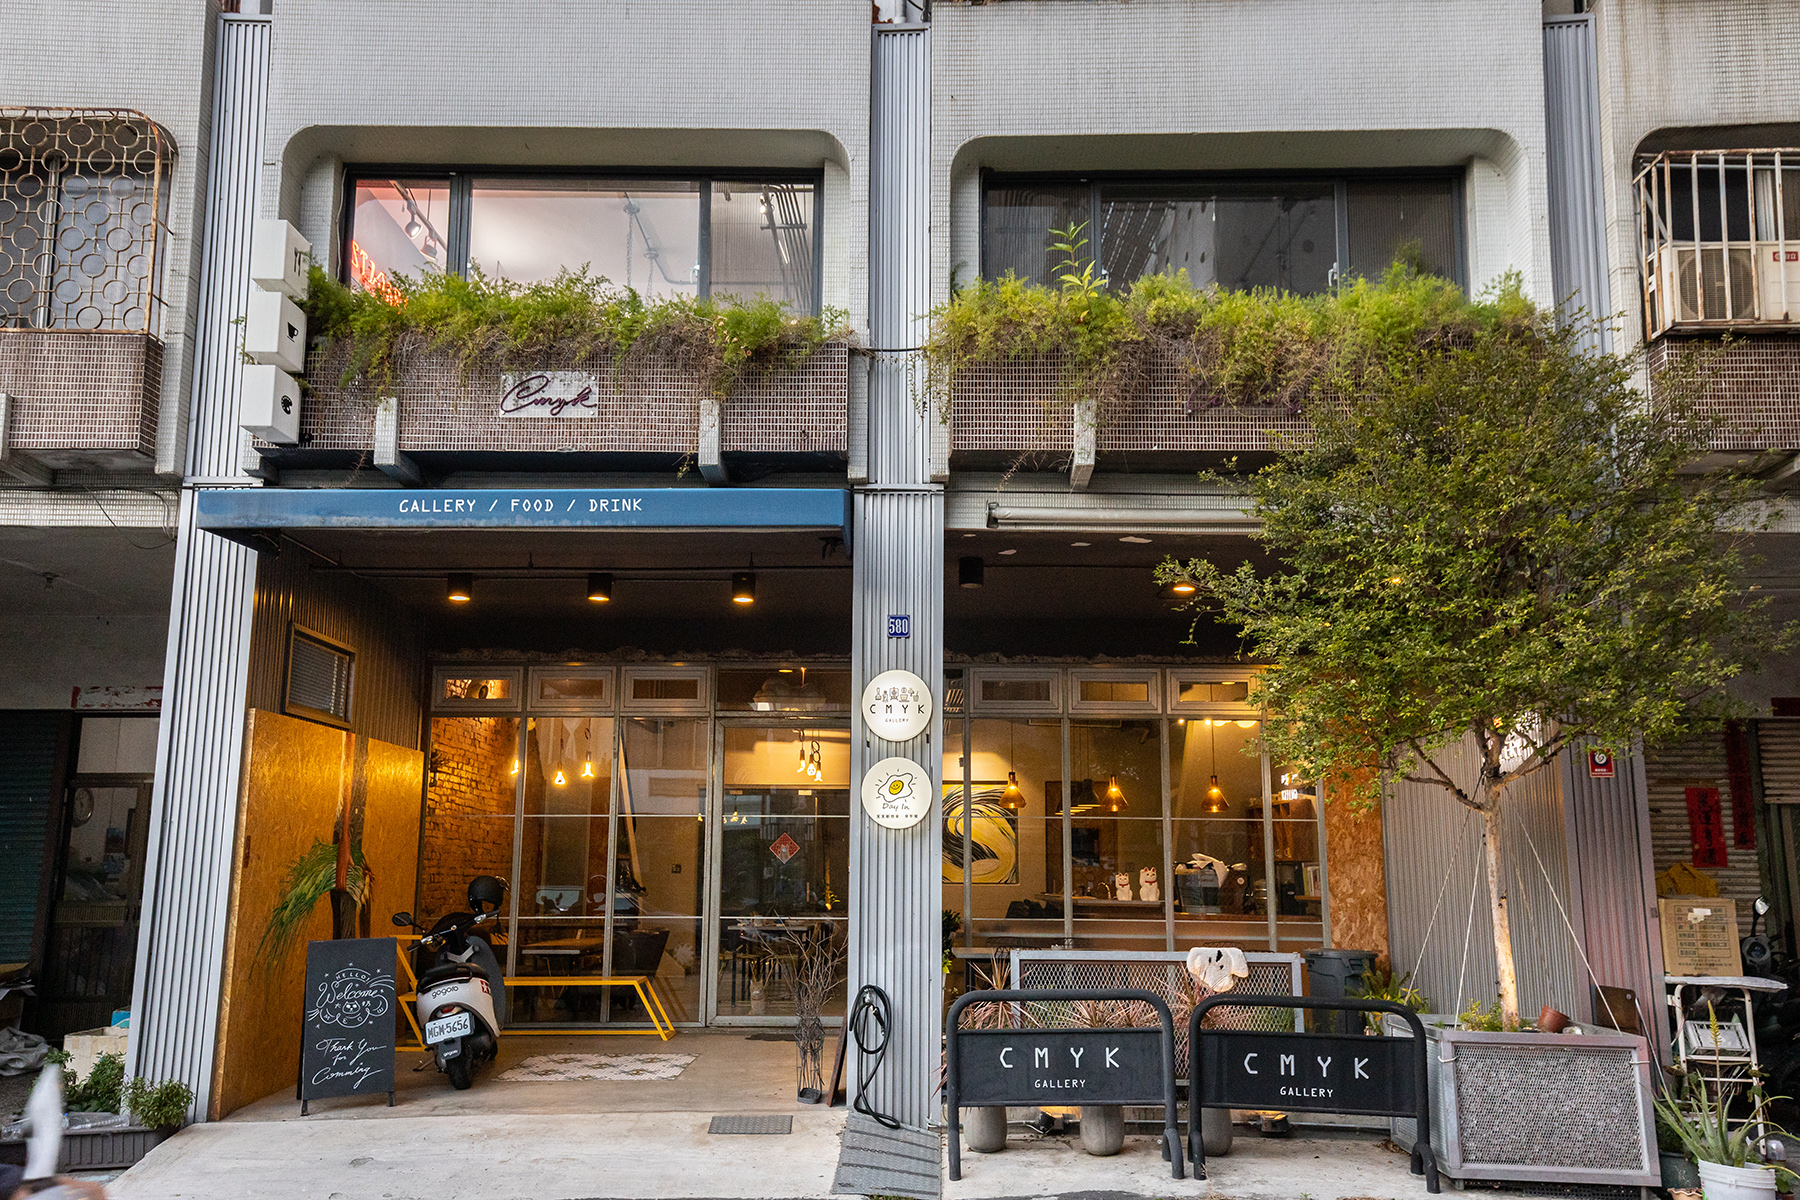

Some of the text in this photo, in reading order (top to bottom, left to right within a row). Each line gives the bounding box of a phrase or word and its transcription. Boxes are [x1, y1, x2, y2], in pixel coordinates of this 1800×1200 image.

[510, 499, 554, 512] FOOD
[588, 498, 642, 512] DRINK
[888, 618, 909, 634] 580
[882, 802, 899, 812] Day
[316, 981, 378, 1008] Welcome
[431, 985, 459, 1000] gogoro
[427, 1018, 469, 1039] MGM-5656
[315, 1037, 387, 1066] Thank You
[332, 1051, 347, 1066] for
[1034, 1079, 1086, 1089] GALLERY
[1279, 1086, 1334, 1098] GALLERY
